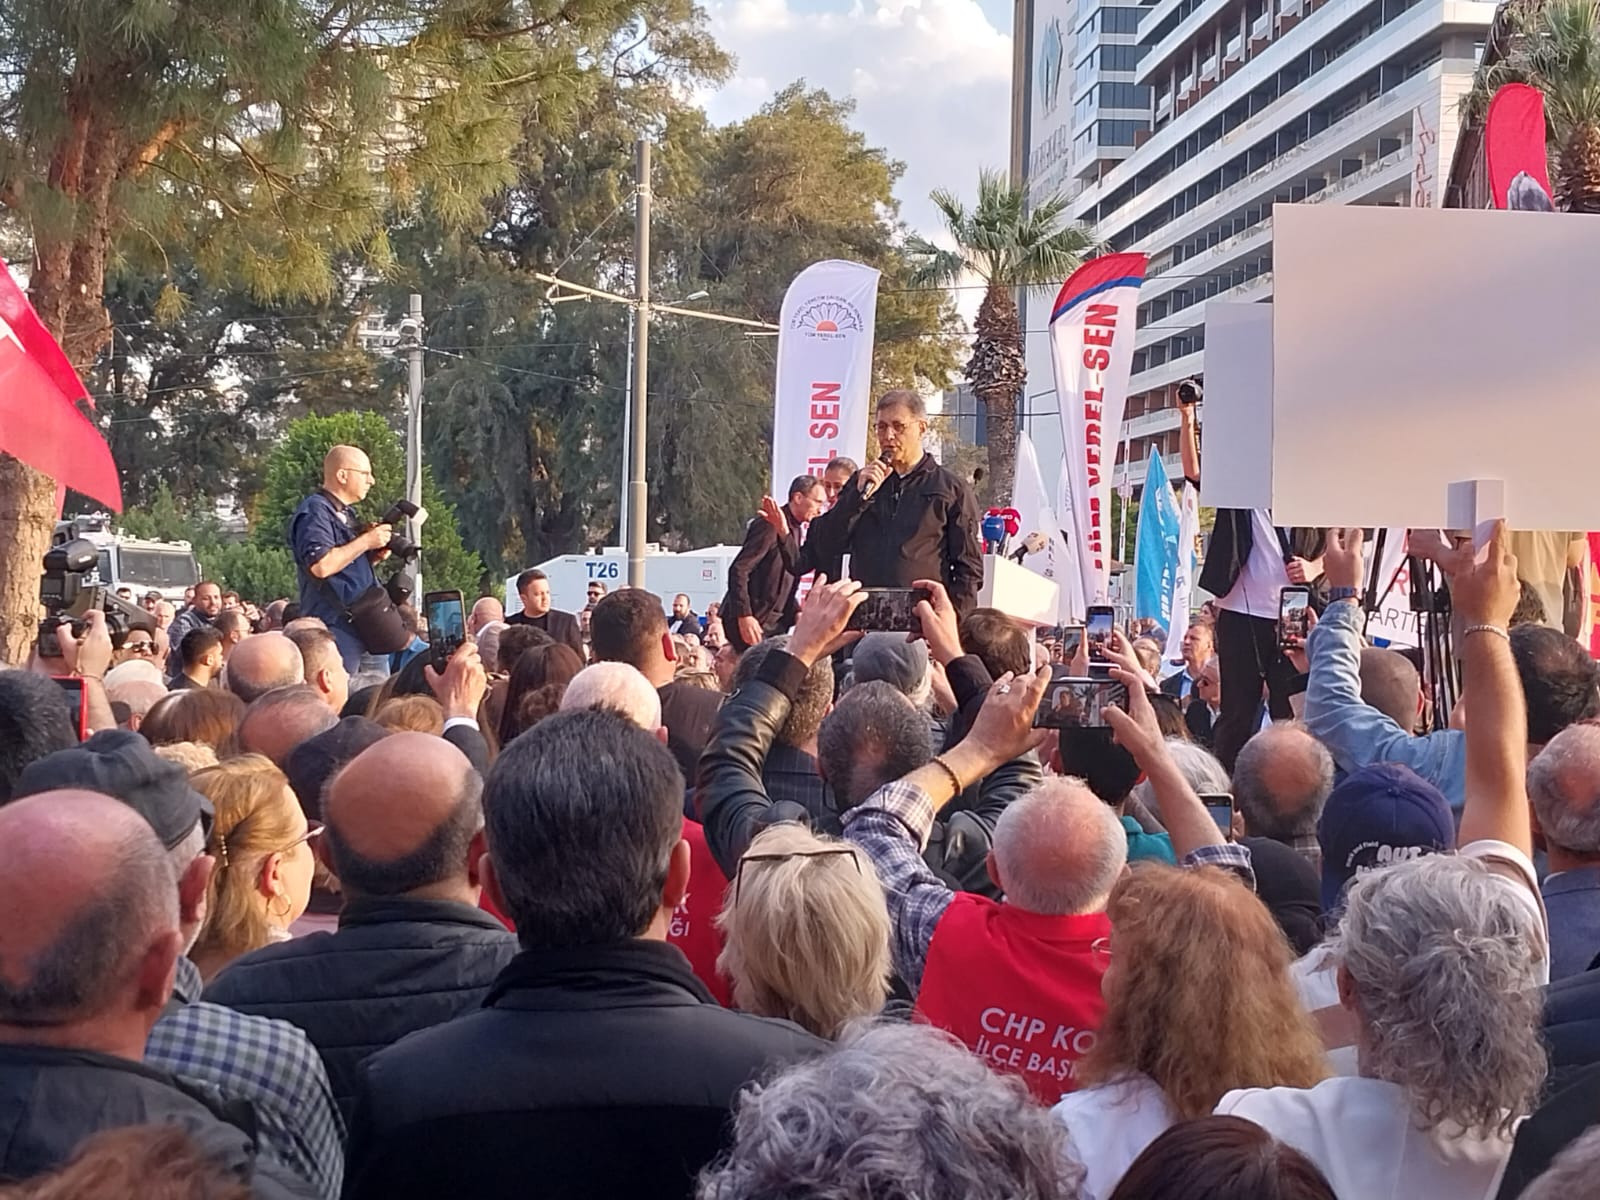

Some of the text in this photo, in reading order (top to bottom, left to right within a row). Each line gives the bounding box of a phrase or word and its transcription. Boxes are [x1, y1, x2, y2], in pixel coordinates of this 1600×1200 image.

[809, 382, 841, 439] SEN
[585, 562, 618, 578] T26
[980, 1007, 1045, 1043] CHP
